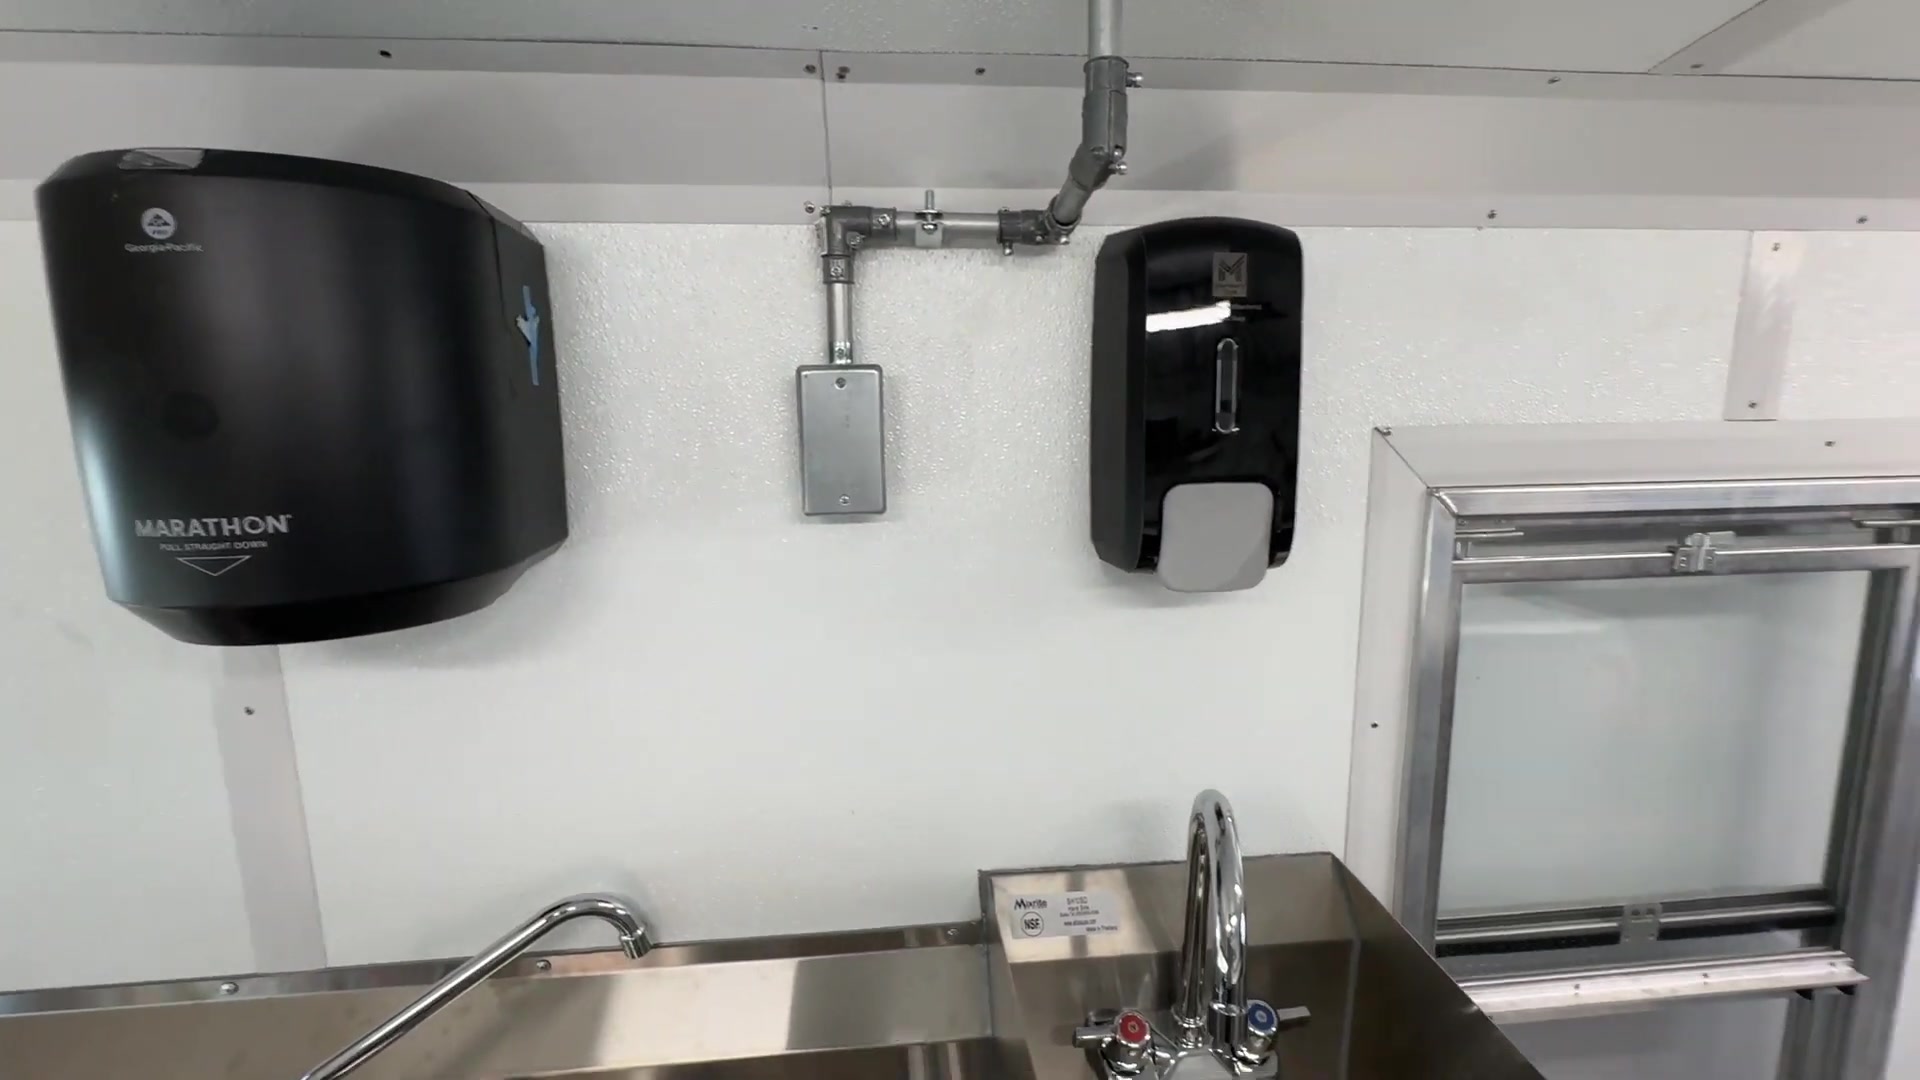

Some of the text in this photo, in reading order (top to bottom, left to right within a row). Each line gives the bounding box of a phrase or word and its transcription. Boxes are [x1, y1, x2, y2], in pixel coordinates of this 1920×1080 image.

[134, 514, 290, 537] MARATHON
[159, 540, 268, 551] PULL STRAIGHT DOWN
[1023, 918, 1040, 930] NSF
